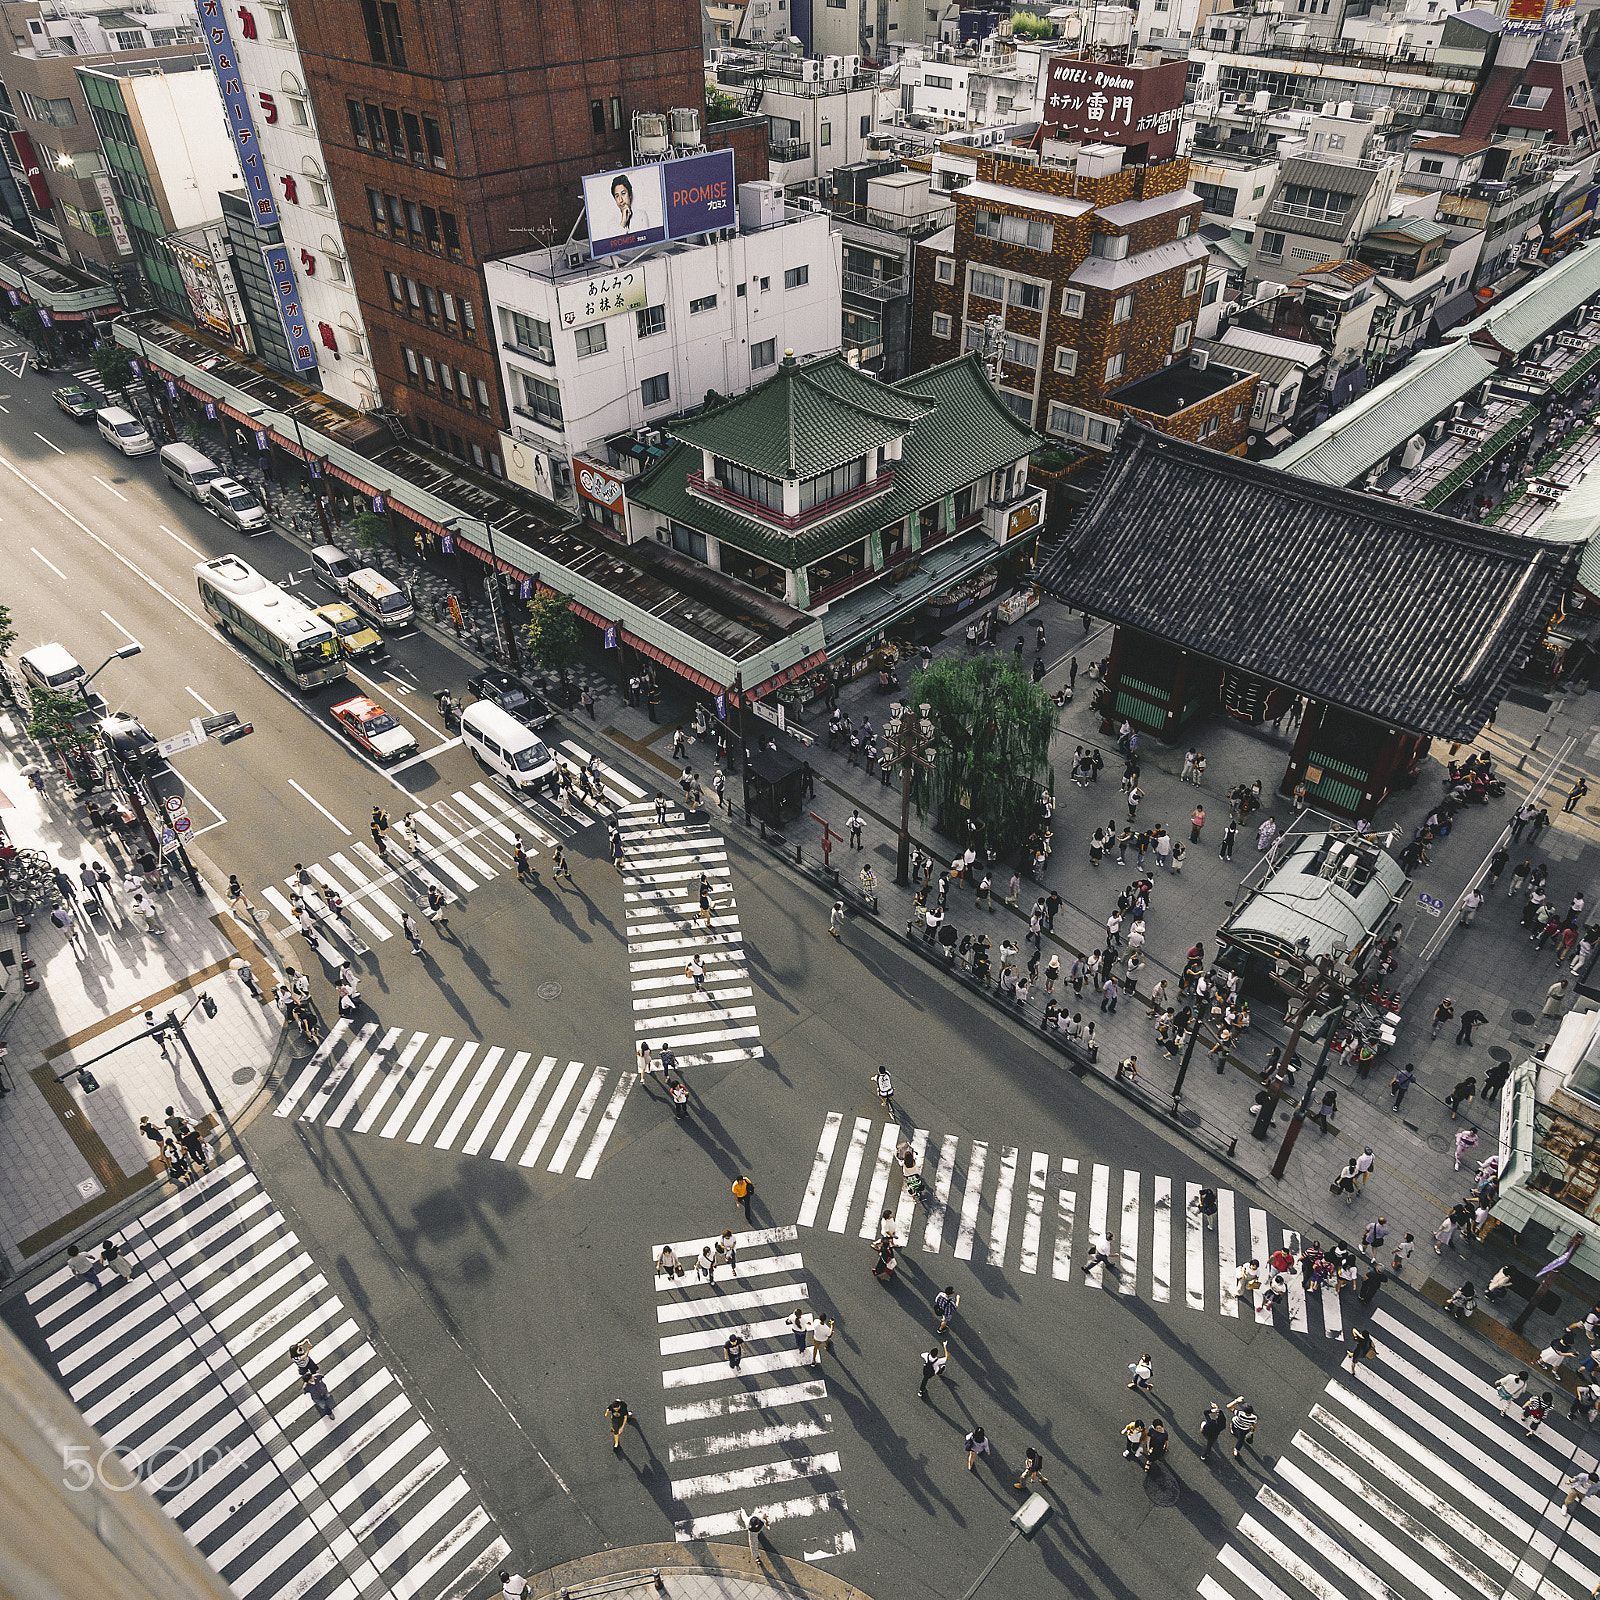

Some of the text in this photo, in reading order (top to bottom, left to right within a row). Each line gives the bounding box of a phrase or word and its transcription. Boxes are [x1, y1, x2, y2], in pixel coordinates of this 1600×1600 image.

[1095, 71, 1134, 90] Ryokan
[28, 166, 40, 177] JTB
[673, 181, 727, 208] PROMISE
[707, 199, 727, 211] プロミス
[610, 235, 635, 248] PROMISE
[588, 273, 633, 296] あんみつ
[274, 259, 312, 359] カラオケ館
[585, 292, 624, 316] お抹茶
